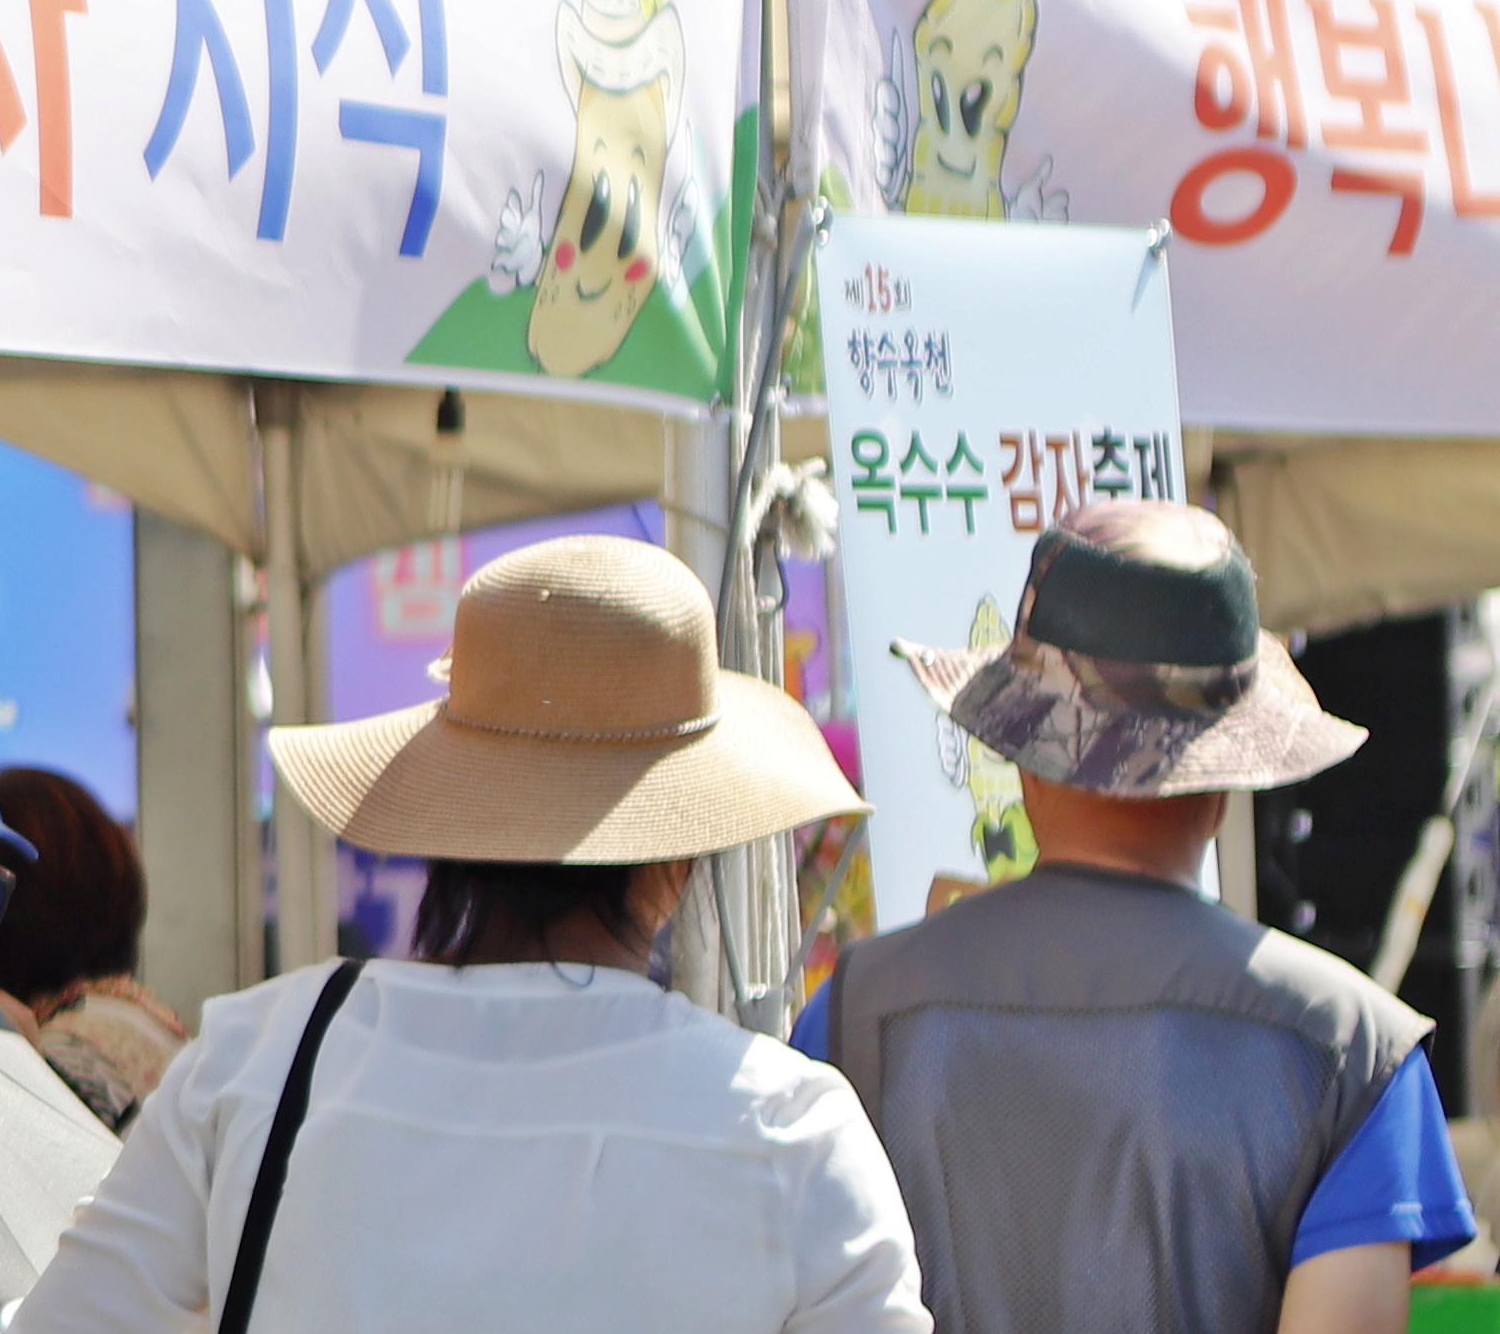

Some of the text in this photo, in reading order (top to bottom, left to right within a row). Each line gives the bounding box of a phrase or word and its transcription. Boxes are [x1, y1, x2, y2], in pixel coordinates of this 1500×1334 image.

[843, 262, 912, 313] 제15회
[847, 327, 953, 405] 향수옥천
[850, 427, 988, 536] 옥수수
